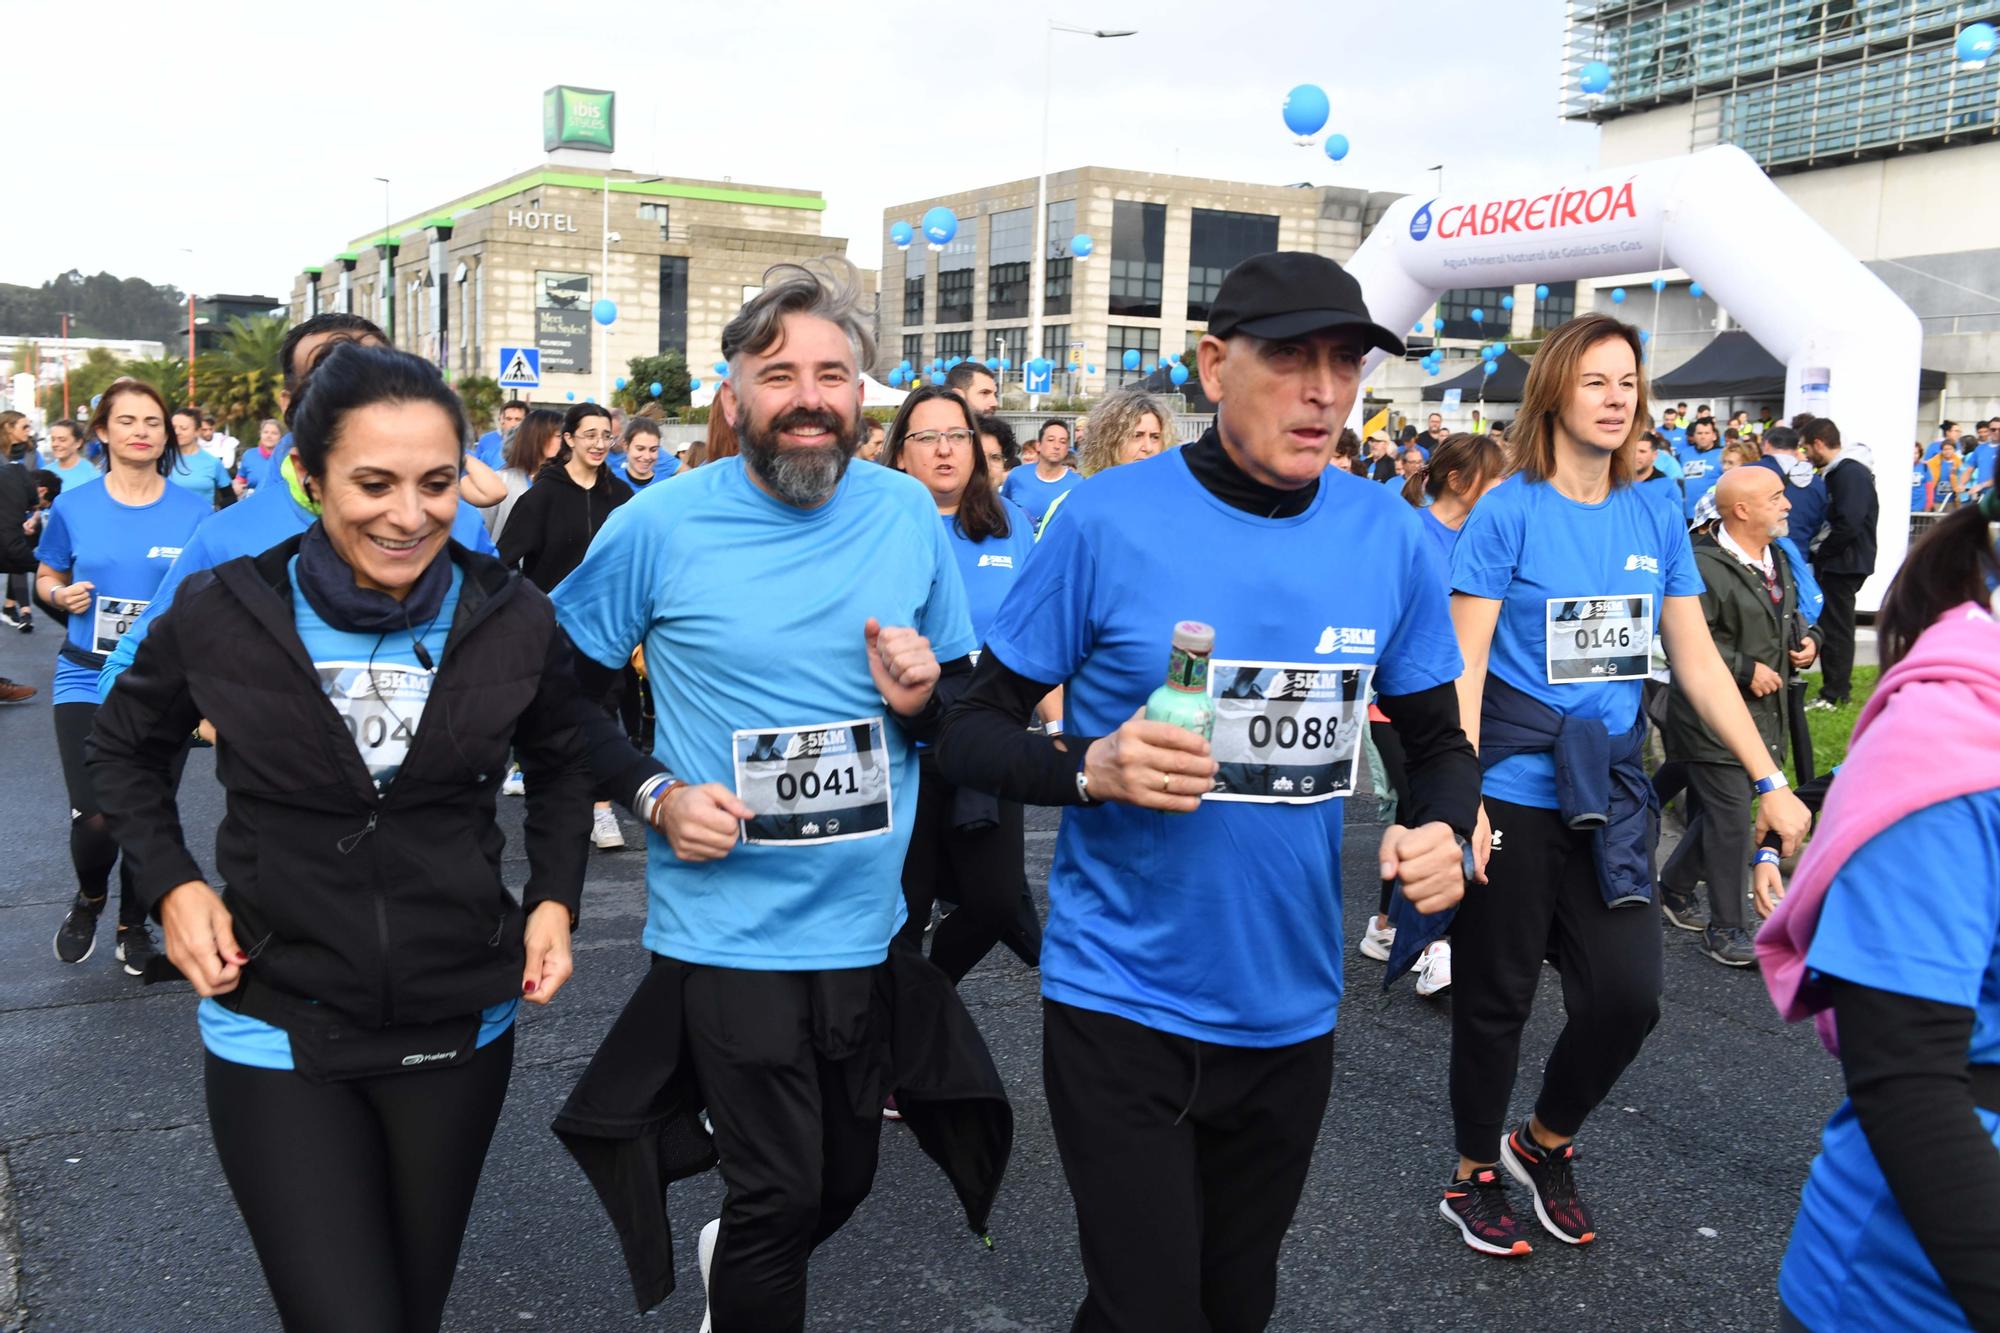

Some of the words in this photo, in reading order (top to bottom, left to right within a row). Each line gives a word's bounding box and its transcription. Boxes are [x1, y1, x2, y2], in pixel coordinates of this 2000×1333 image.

[575, 101, 600, 118] ibis
[508, 210, 578, 232] HOTEL
[1444, 258, 1468, 270] Agua
[1468, 253, 1505, 266] Mineral
[1506, 249, 1546, 262] Natural
[1548, 248, 1560, 260] de
[1562, 244, 1600, 258] Galicia
[1600, 242, 1619, 254] Sin
[1620, 240, 1643, 252] Gas
[1340, 628, 1376, 646] 5KM
[1574, 627, 1630, 650] 0146
[379, 673, 429, 691] 5KM
[1294, 672, 1336, 688] 5KM
[808, 730, 846, 748] 5KM
[1248, 715, 1338, 750] 0088
[776, 766, 859, 800] 0041
